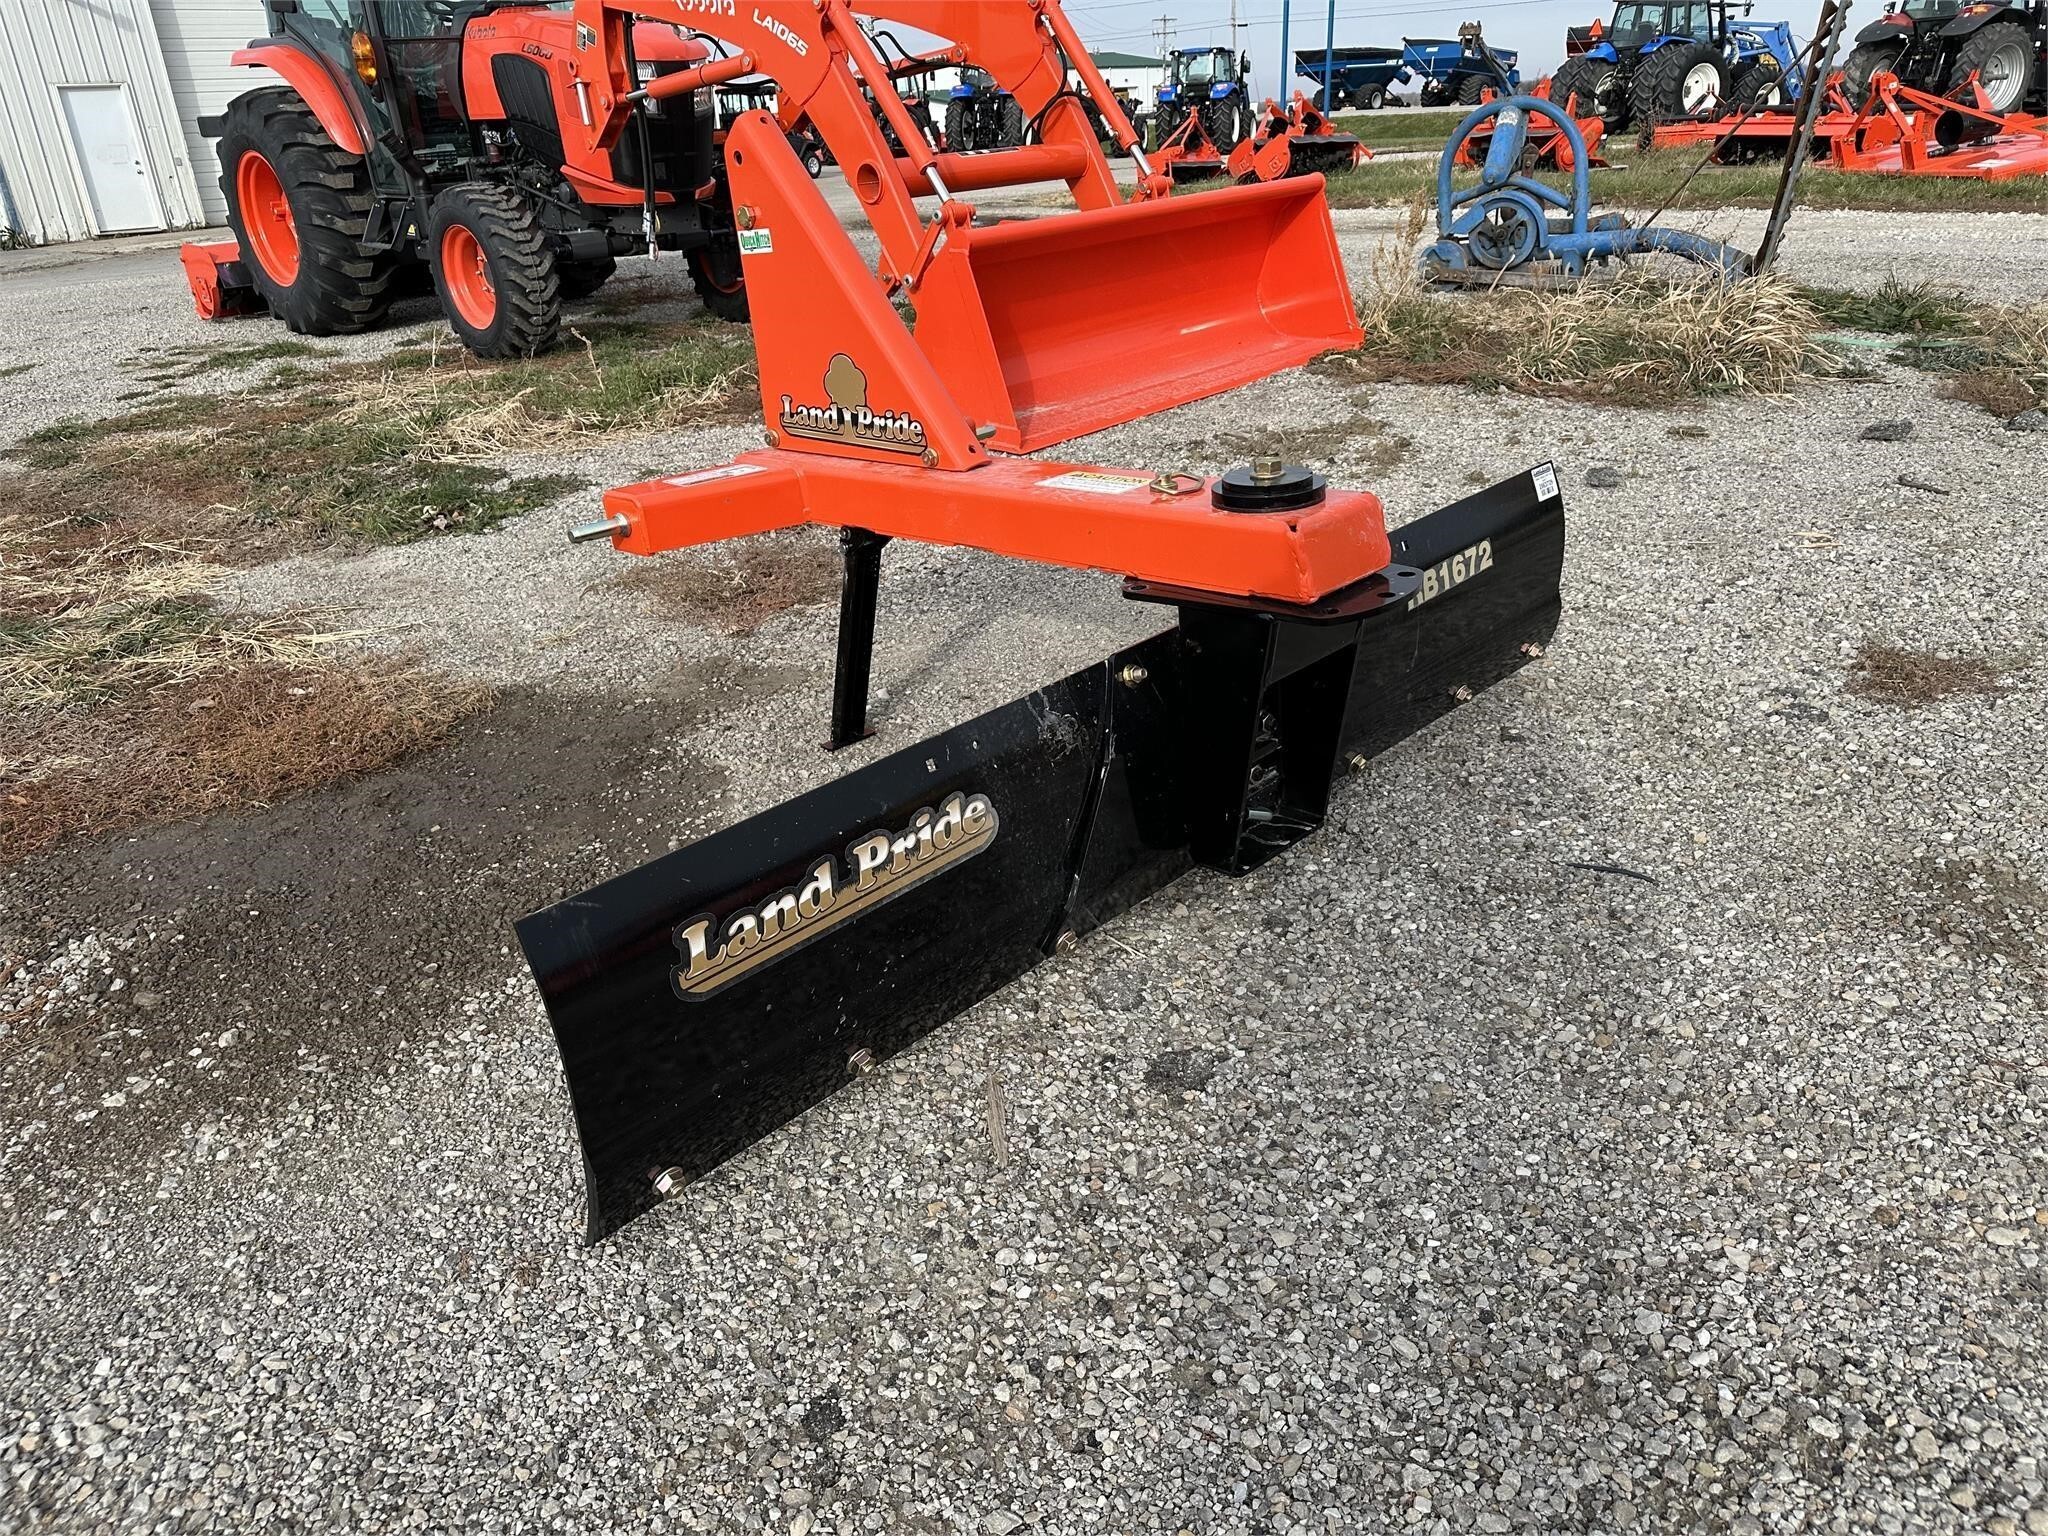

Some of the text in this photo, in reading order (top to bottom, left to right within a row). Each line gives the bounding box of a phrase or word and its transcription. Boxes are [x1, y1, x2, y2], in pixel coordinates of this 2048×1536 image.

[465, 24, 496, 39] Kubota
[752, 7, 809, 57] LA1065
[781, 395, 924, 443] Land Pride
[681, 796, 988, 980] Land Pride
